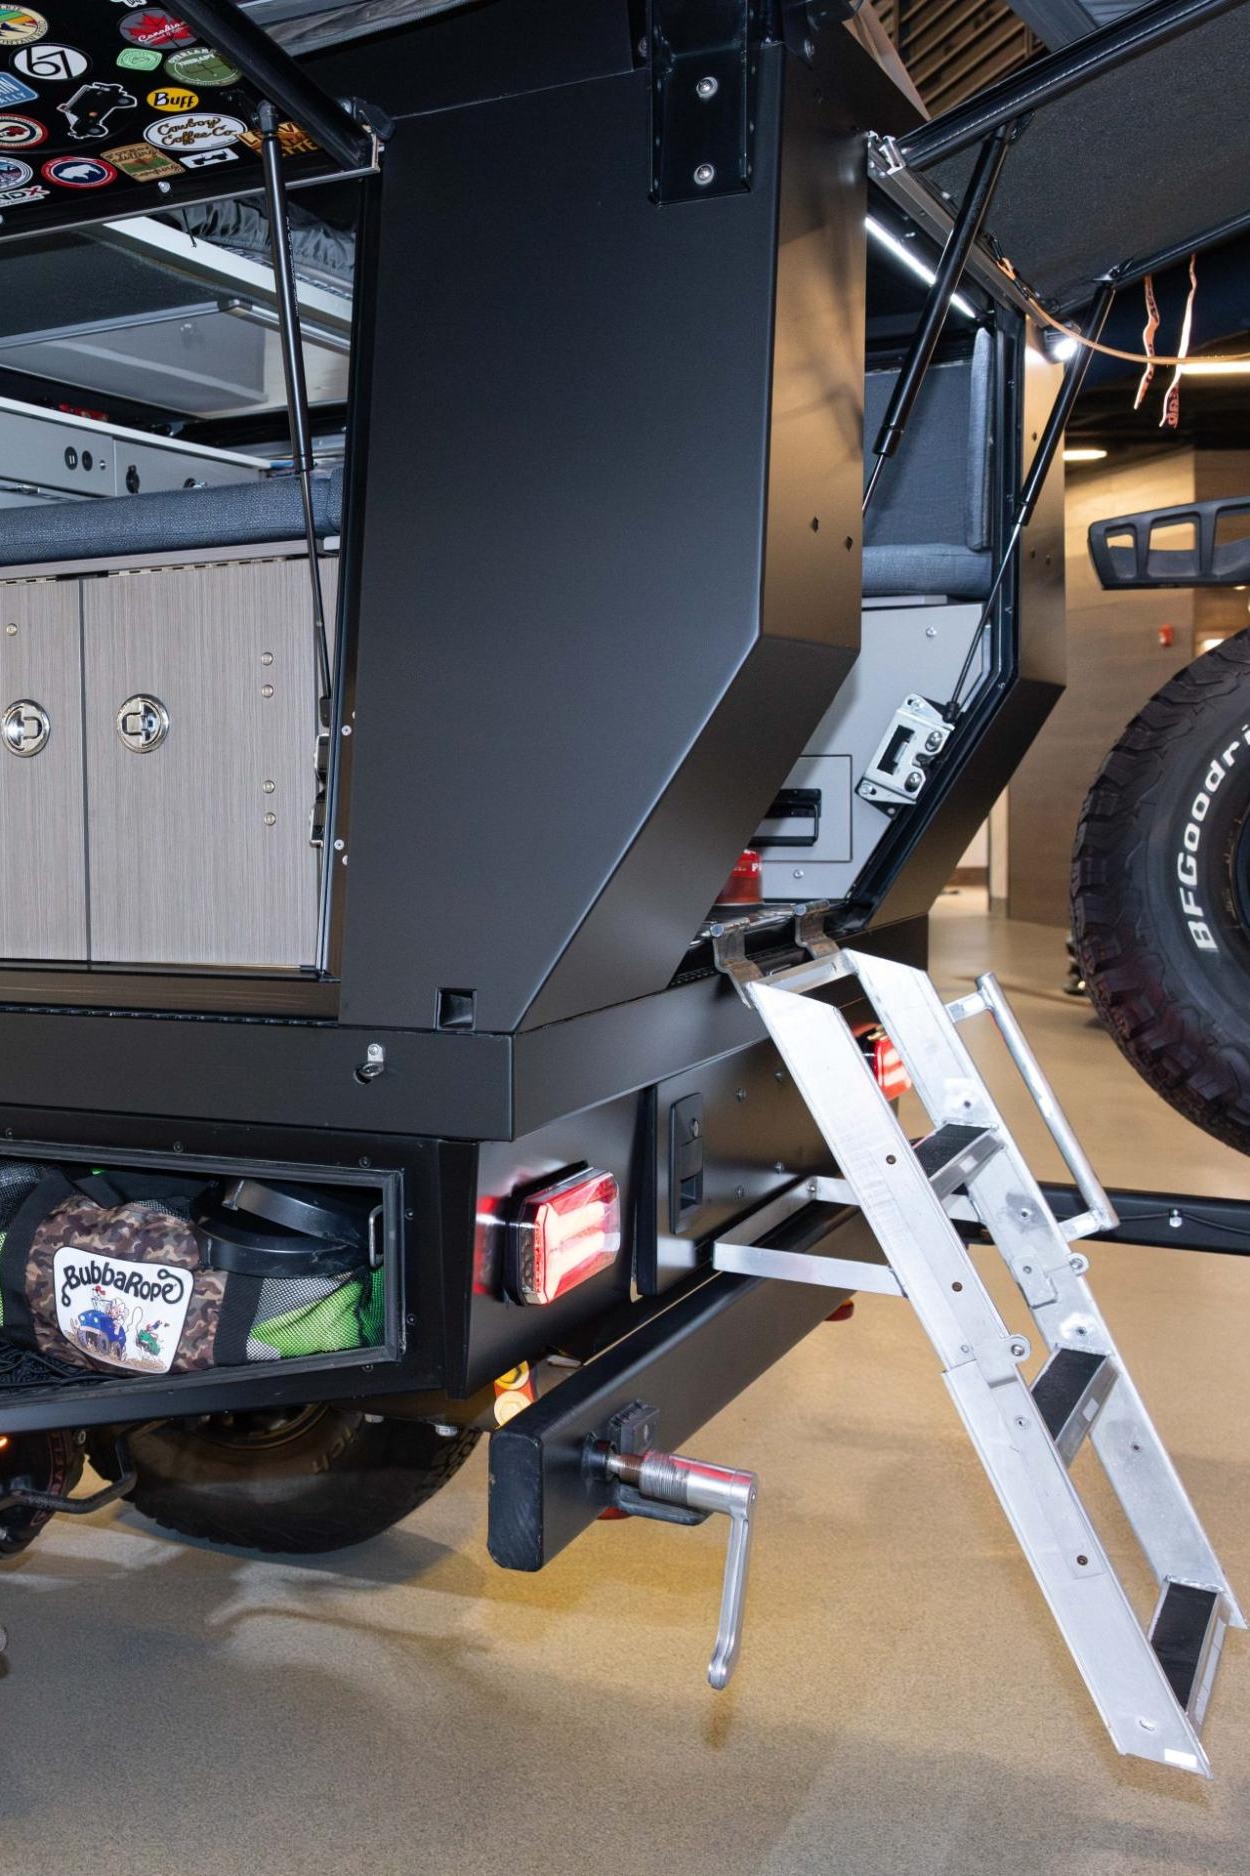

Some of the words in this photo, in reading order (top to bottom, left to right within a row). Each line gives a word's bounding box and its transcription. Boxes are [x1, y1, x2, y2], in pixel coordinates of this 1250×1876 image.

[154, 92, 198, 108] Buff
[157, 117, 221, 135] Cowboy
[161, 129, 213, 146] Coffee
